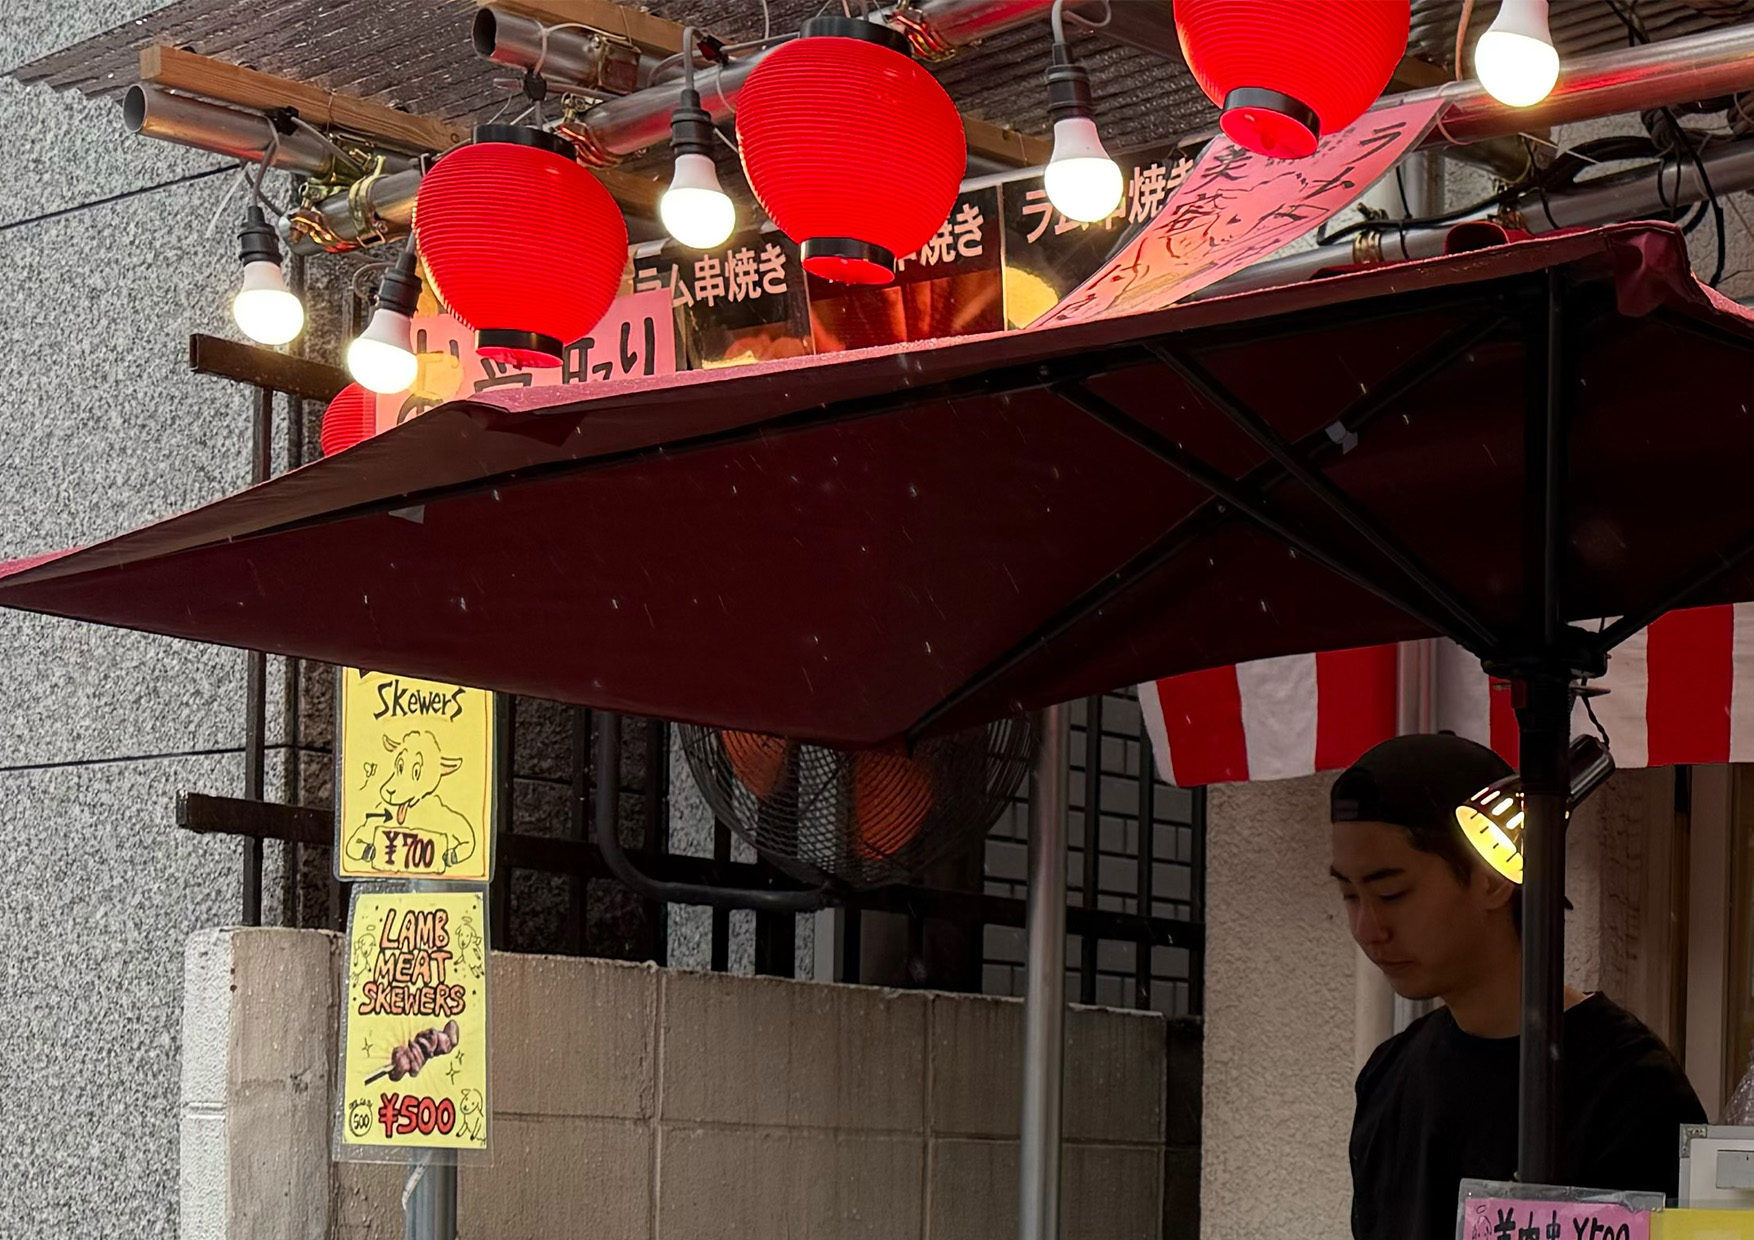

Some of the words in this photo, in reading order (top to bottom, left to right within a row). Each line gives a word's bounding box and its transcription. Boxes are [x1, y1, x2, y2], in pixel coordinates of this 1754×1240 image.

[1022, 157, 1194, 244] ラ焼き
[373, 679, 466, 723] Skewers
[384, 831, 435, 868] ¥700
[380, 909, 449, 950] LAMB
[373, 949, 453, 984] MEAT
[358, 985, 466, 1017] SKEWERS
[378, 1093, 456, 1138] ¥500
